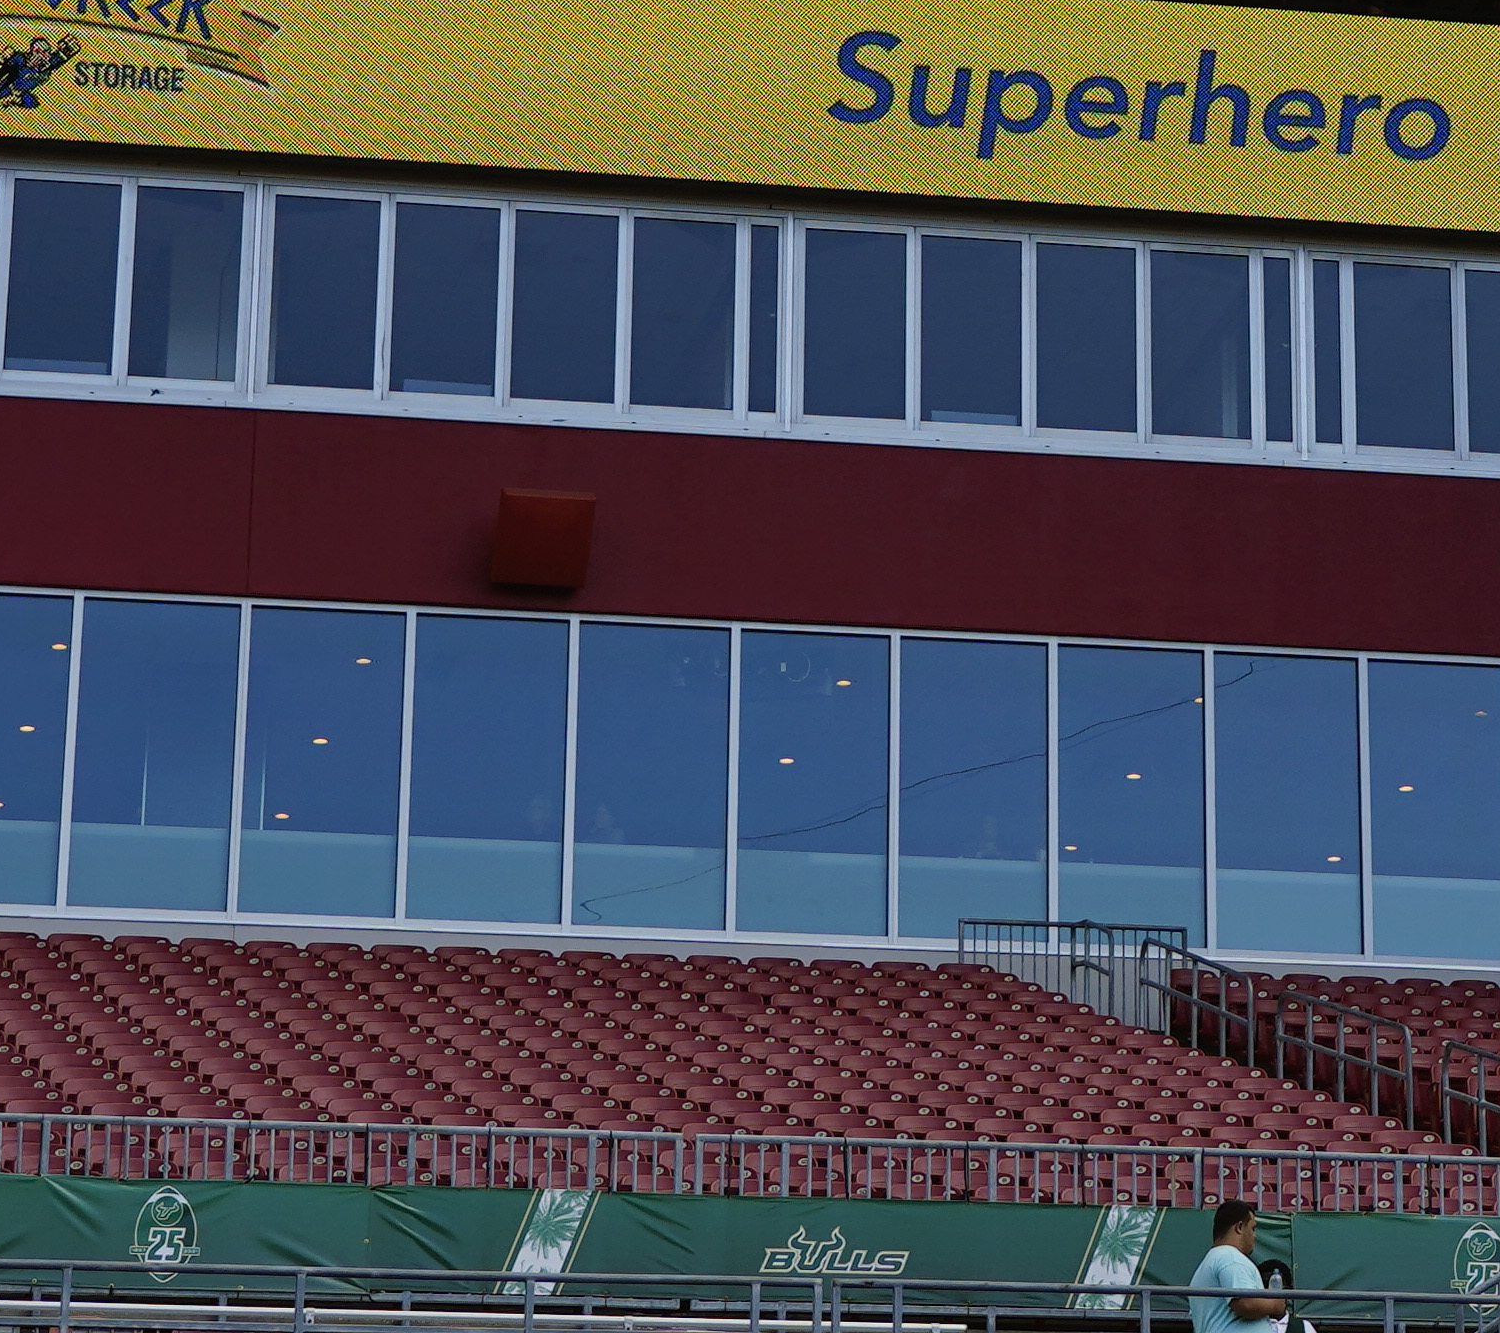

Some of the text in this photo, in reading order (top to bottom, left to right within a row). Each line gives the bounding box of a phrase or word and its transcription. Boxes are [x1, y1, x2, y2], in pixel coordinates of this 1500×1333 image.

[73, 61, 186, 93] STORAGE
[825, 29, 1453, 160] Superhero
[145, 1227, 187, 1263] 25
[758, 1224, 911, 1275] BULLS
